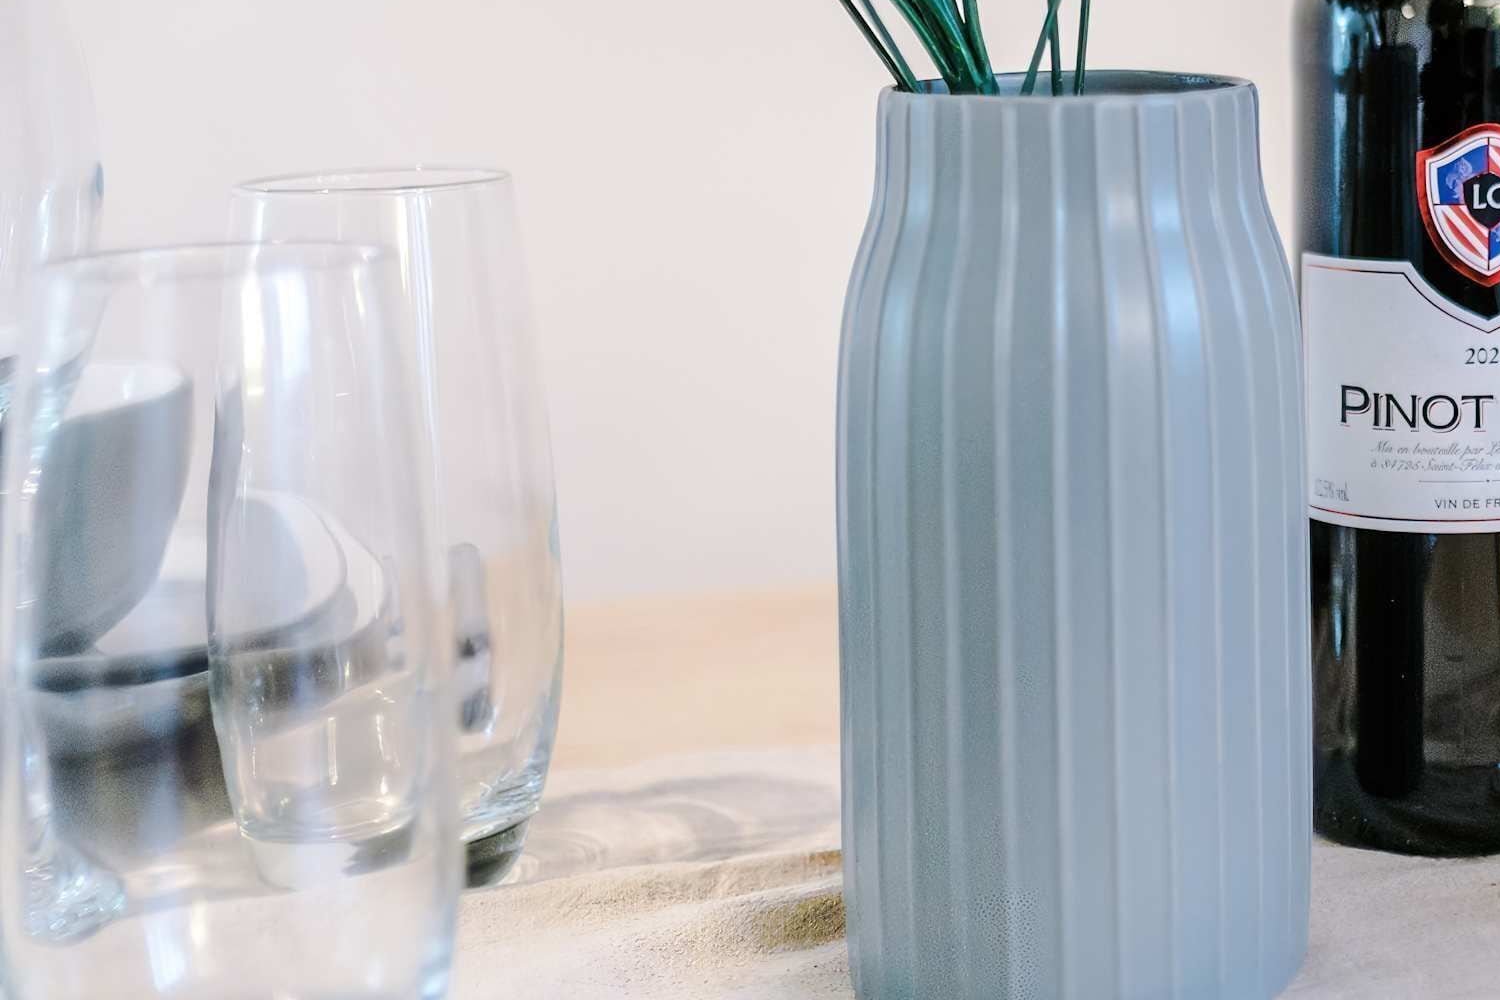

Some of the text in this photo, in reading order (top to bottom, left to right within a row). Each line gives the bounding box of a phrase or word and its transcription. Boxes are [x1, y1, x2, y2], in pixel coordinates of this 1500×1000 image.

[1340, 384, 1494, 433] PINOT
[1397, 446, 1409, 455] en
[1459, 444, 1484, 460] par
[1434, 498, 1458, 510] VIN
[1463, 498, 1480, 509] DE
